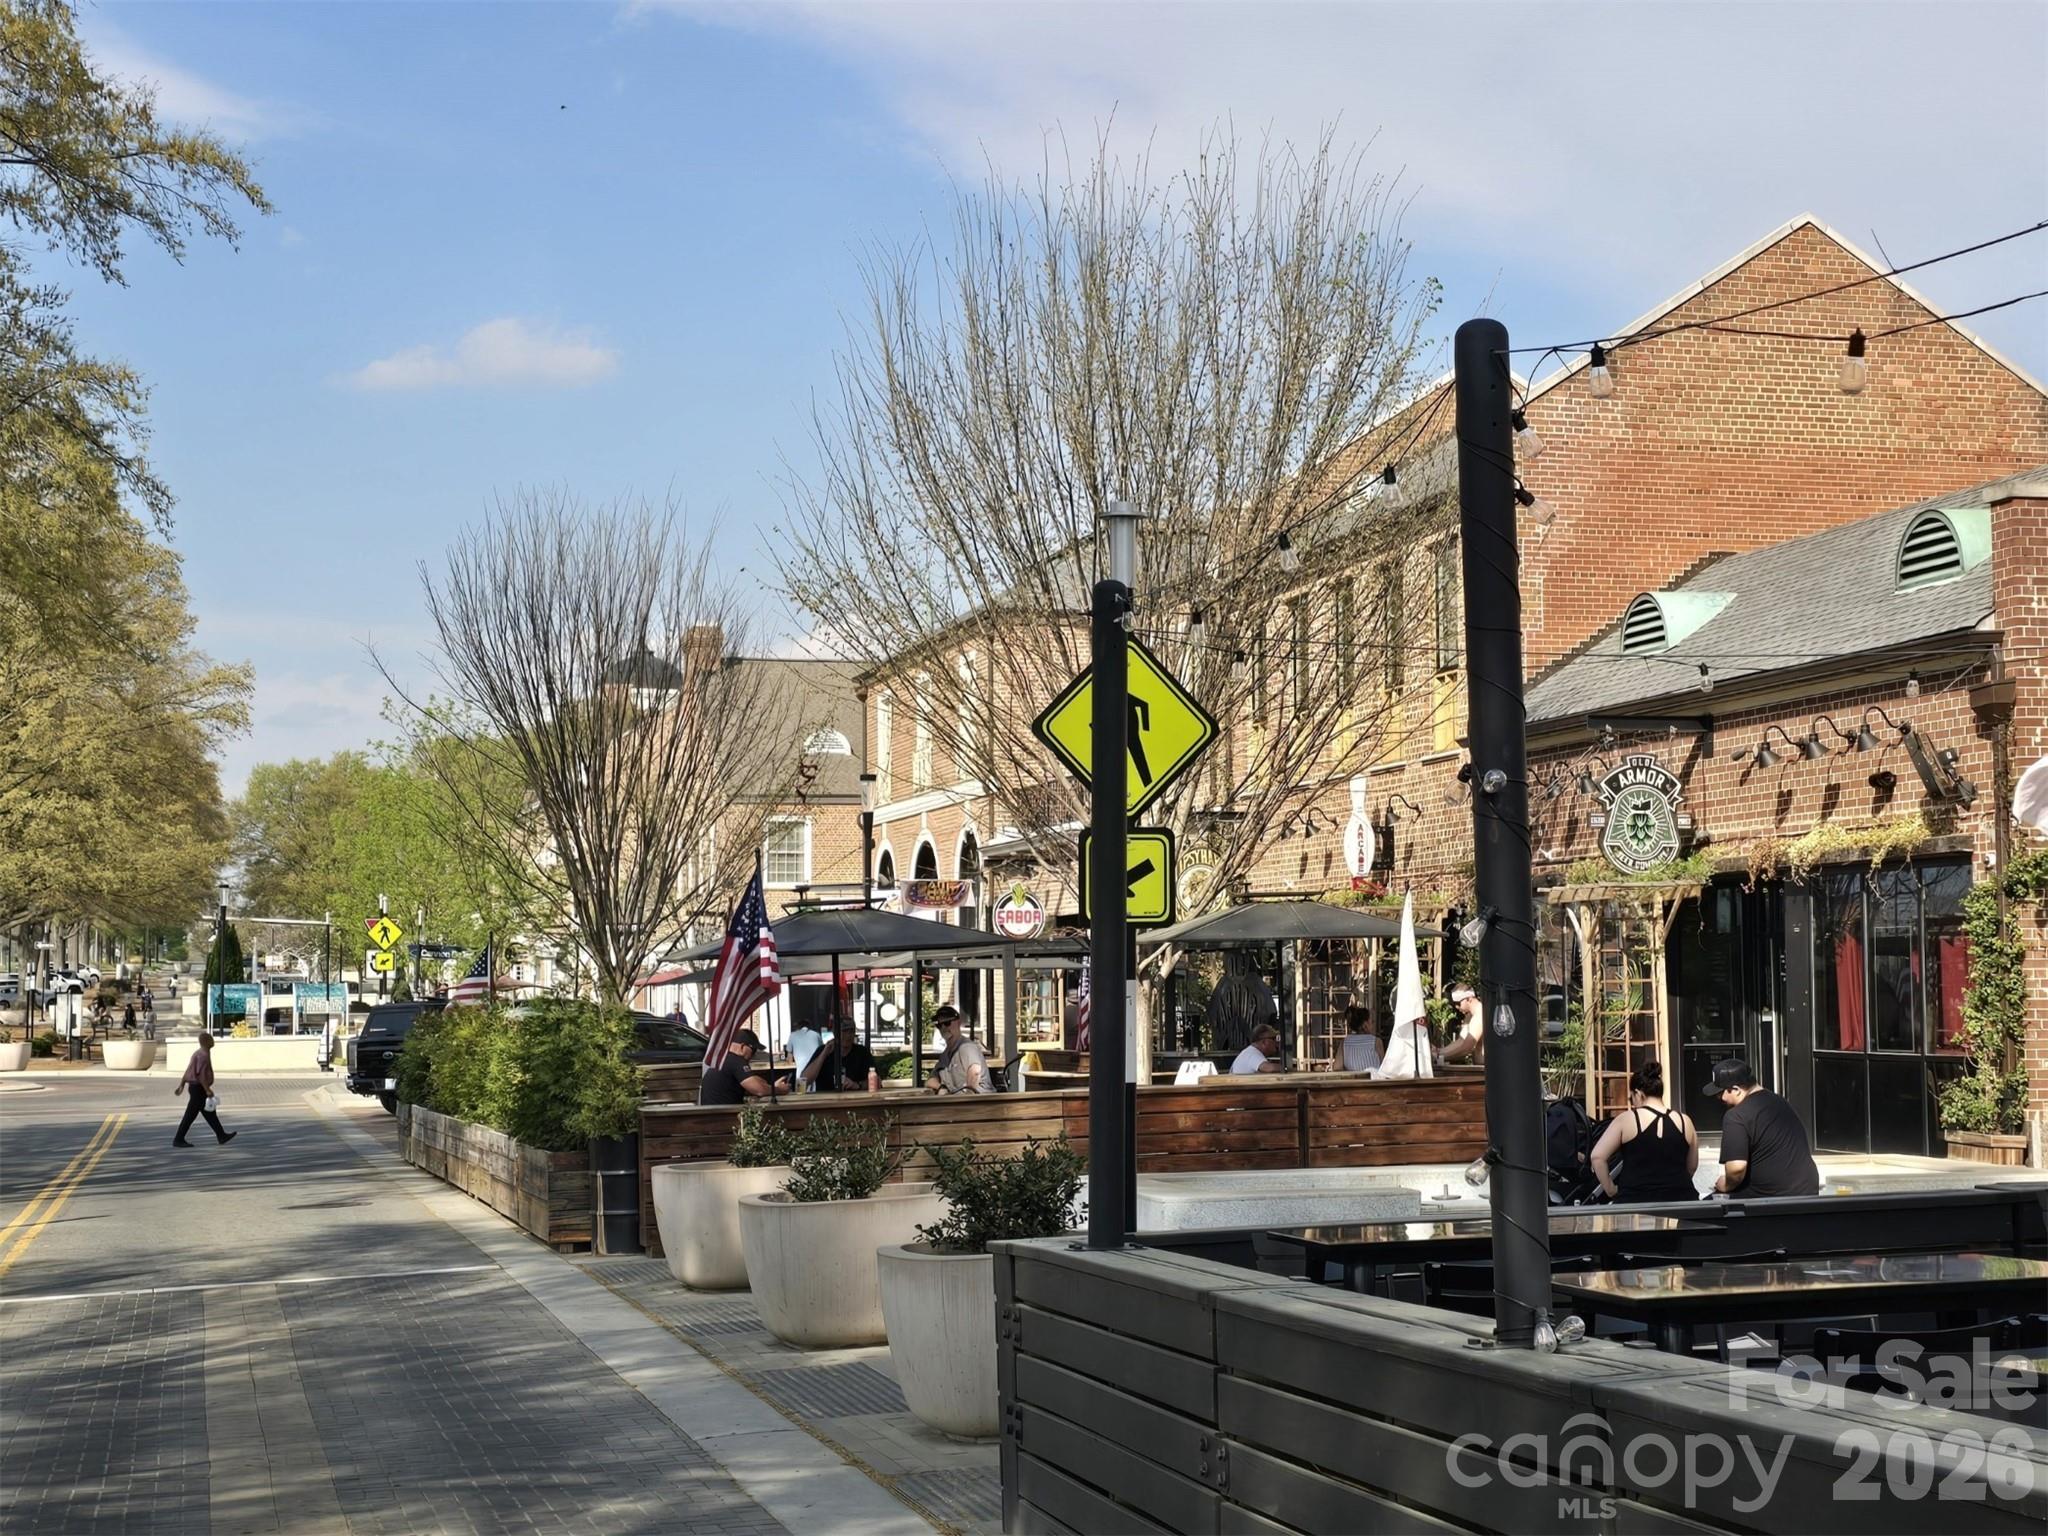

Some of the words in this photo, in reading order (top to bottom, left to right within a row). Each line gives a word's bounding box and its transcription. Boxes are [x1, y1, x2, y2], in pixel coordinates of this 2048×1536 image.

[1632, 758, 1650, 767] OLD
[1618, 768, 1665, 788] ARMOR
[1357, 823, 1365, 873] ARCADE
[997, 910, 1041, 923] SABOR
